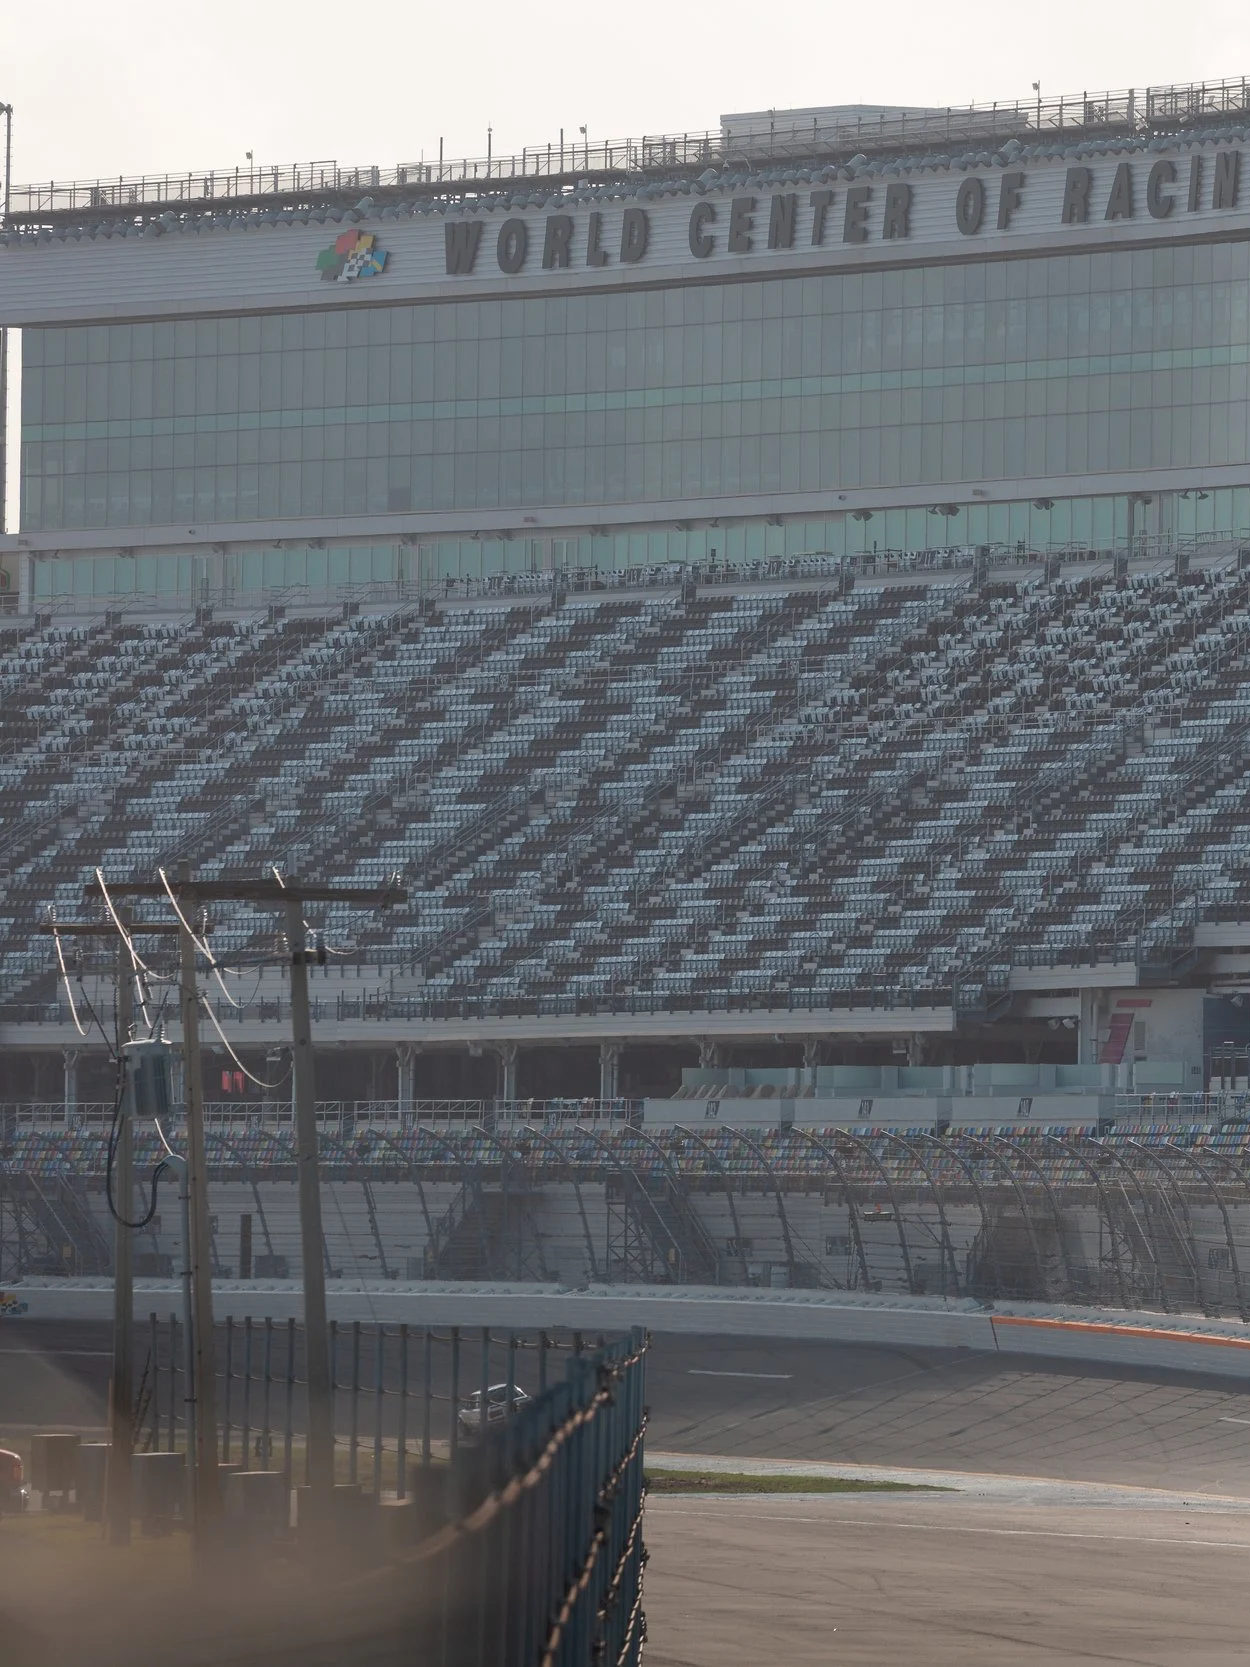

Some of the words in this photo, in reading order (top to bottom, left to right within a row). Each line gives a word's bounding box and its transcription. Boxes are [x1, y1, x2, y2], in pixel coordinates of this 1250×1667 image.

[445, 208, 648, 275] WORLD
[689, 184, 912, 259] CENTER
[956, 171, 1025, 236] OF
